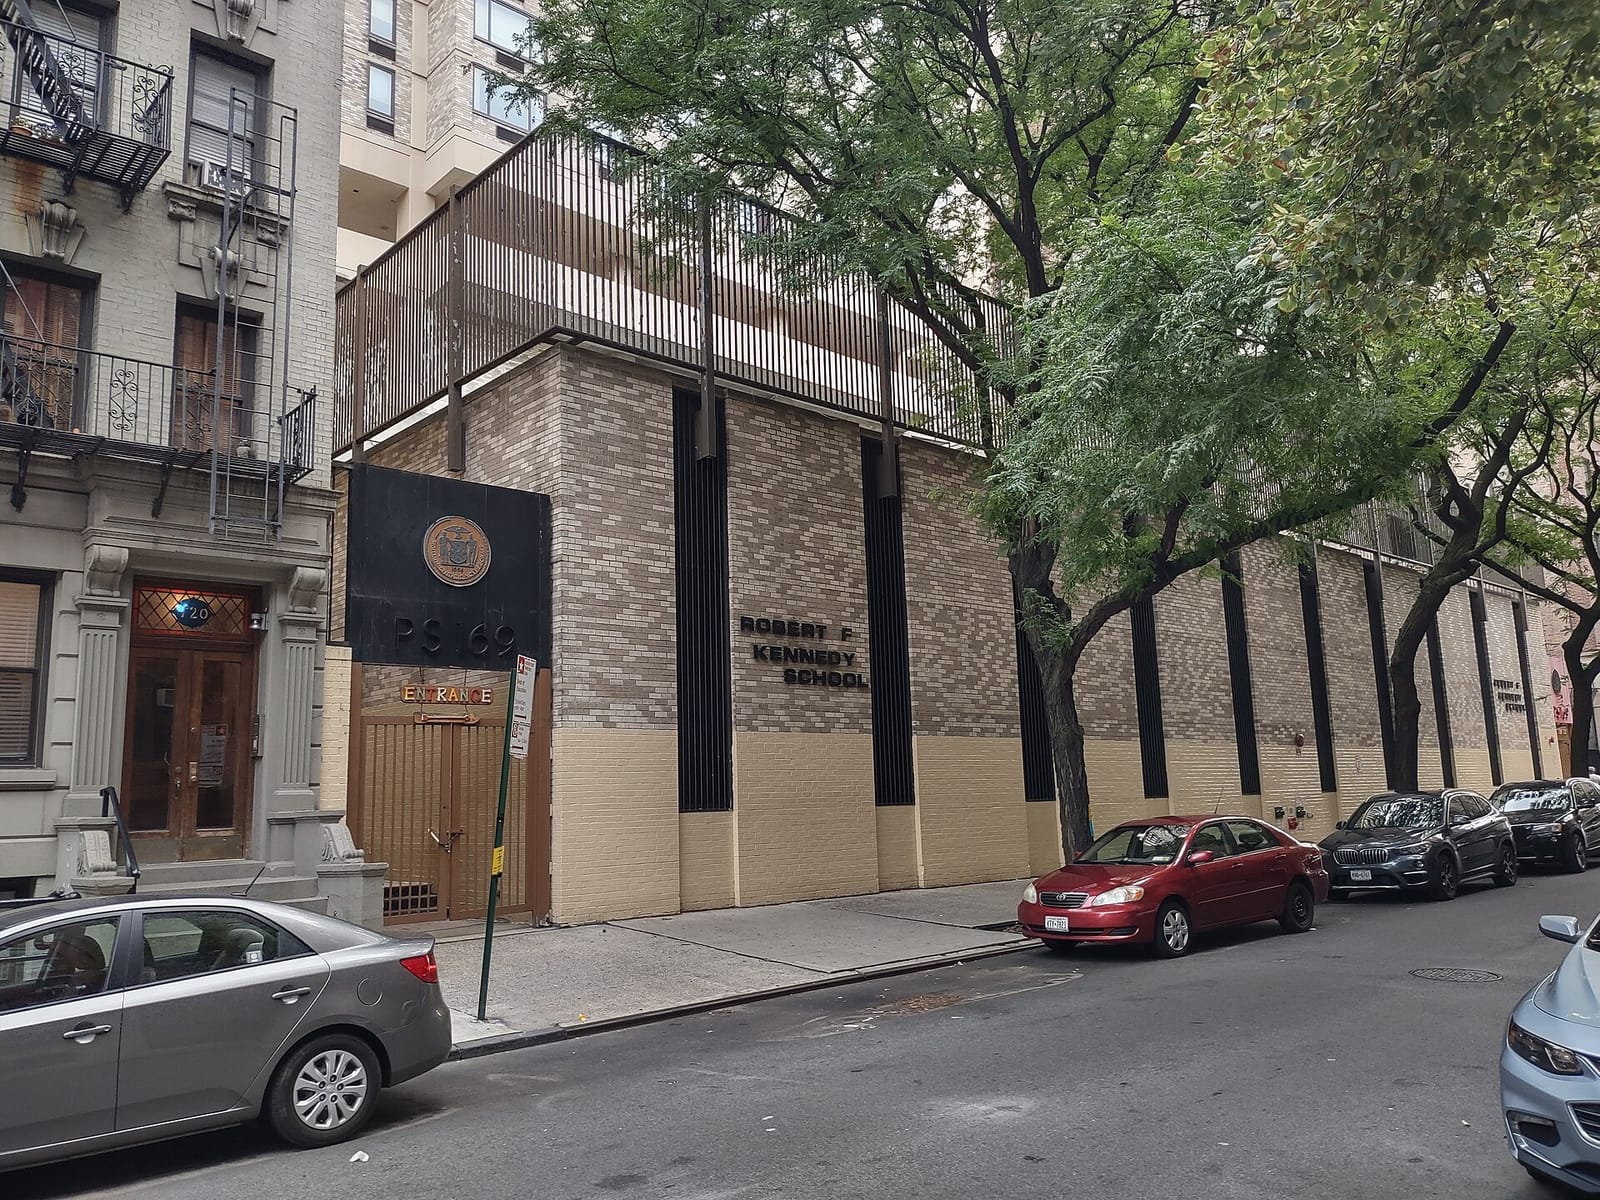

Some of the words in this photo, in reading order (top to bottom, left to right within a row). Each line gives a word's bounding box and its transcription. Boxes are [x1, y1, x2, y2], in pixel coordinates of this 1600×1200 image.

[394, 616, 442, 653] PS
[740, 616, 827, 641] ROBERT
[841, 627, 853, 641] F
[753, 644, 856, 667] KENNEDY
[783, 668, 869, 688] SCHOOL
[404, 686, 492, 703] ENTRANCE
